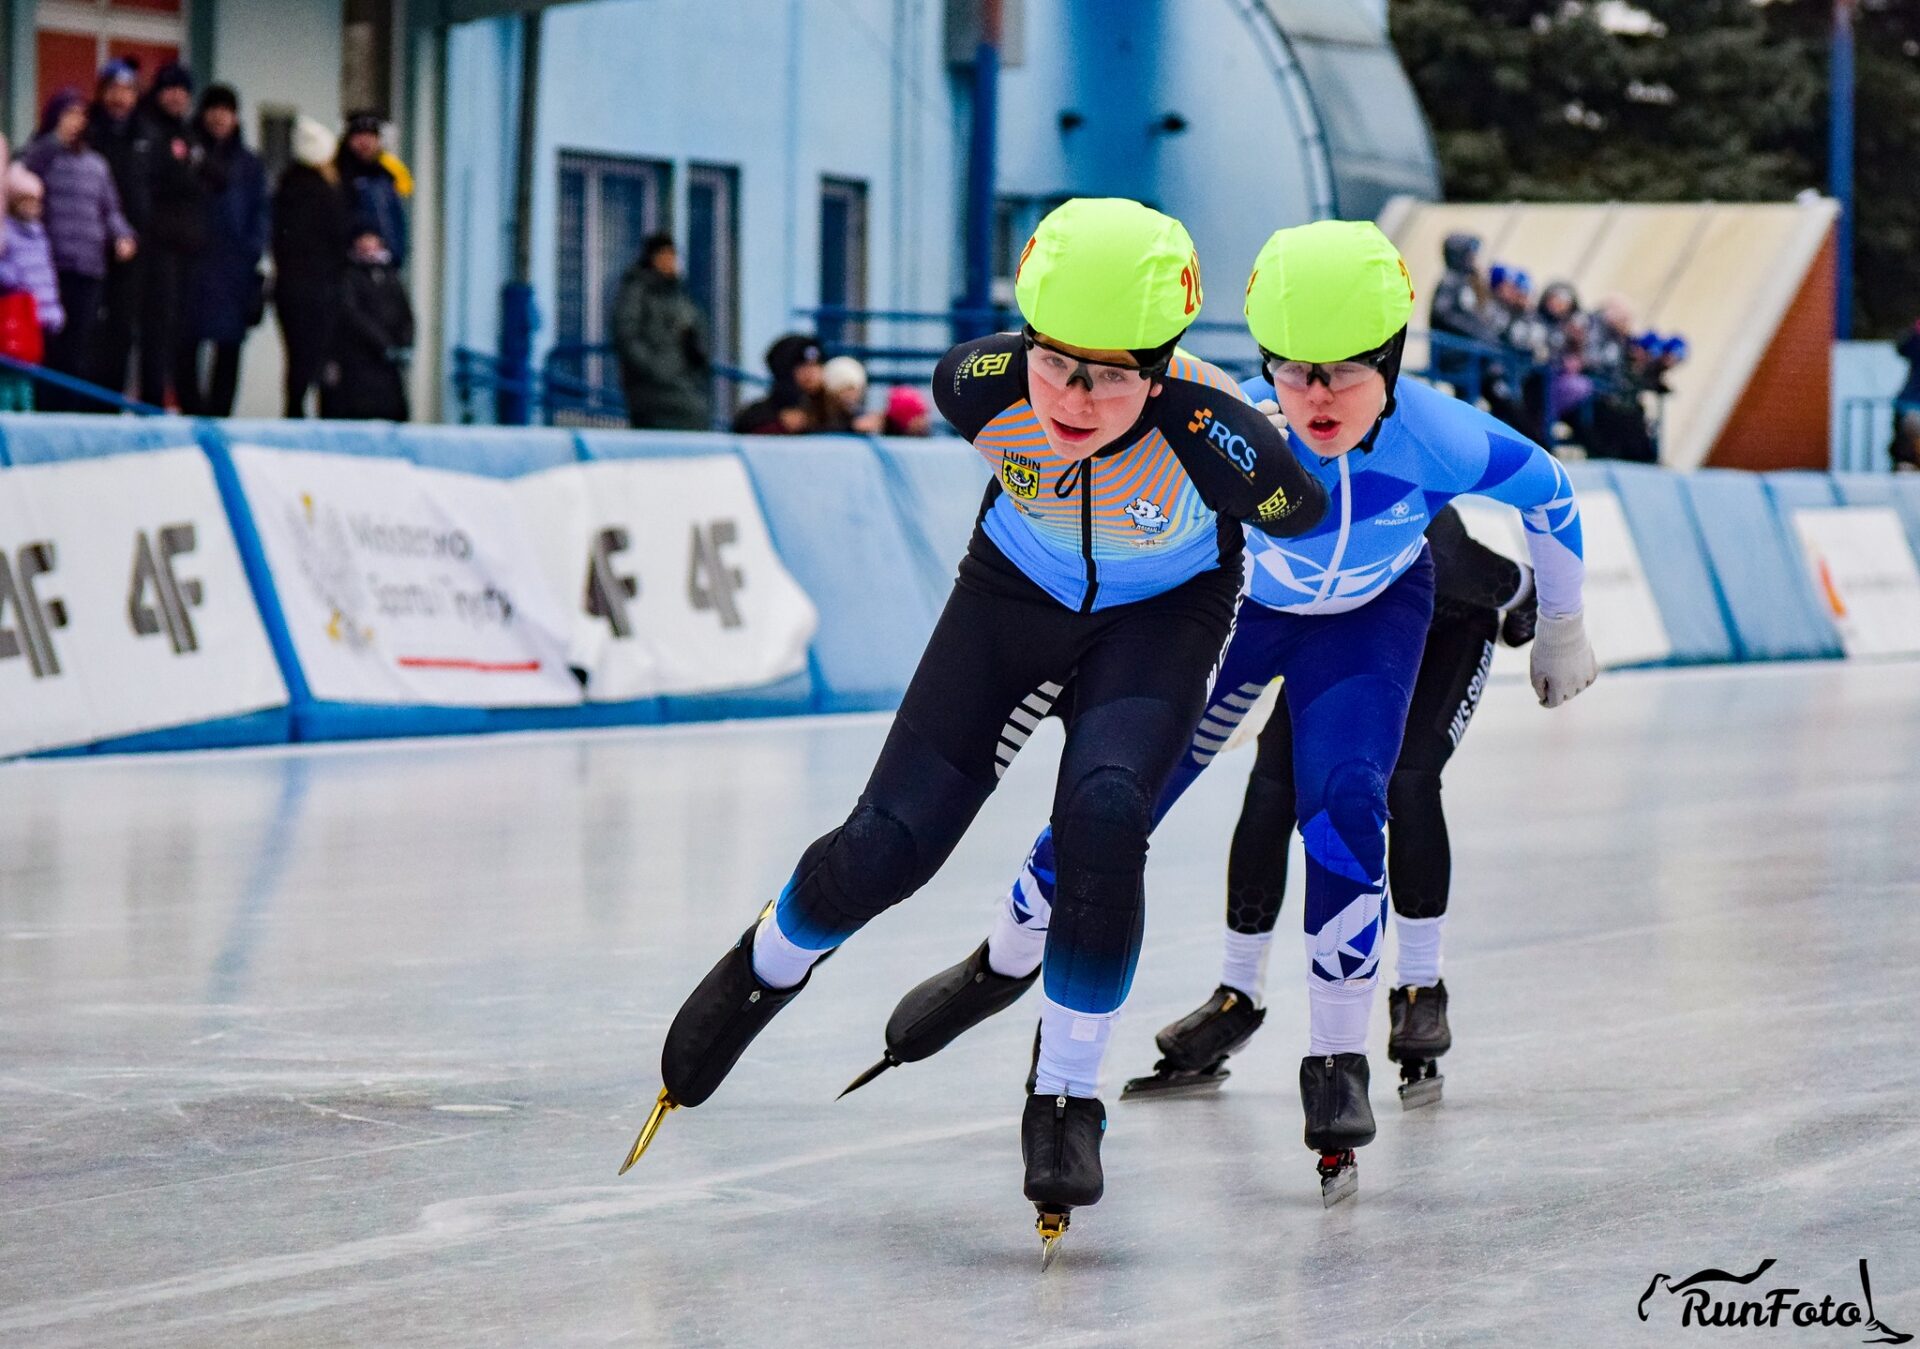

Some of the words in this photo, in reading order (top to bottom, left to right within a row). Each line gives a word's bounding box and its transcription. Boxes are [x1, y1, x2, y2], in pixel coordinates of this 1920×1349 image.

[1003, 448, 1041, 471] LUBIN
[128, 523, 202, 653] 4F
[689, 521, 743, 629] 4F
